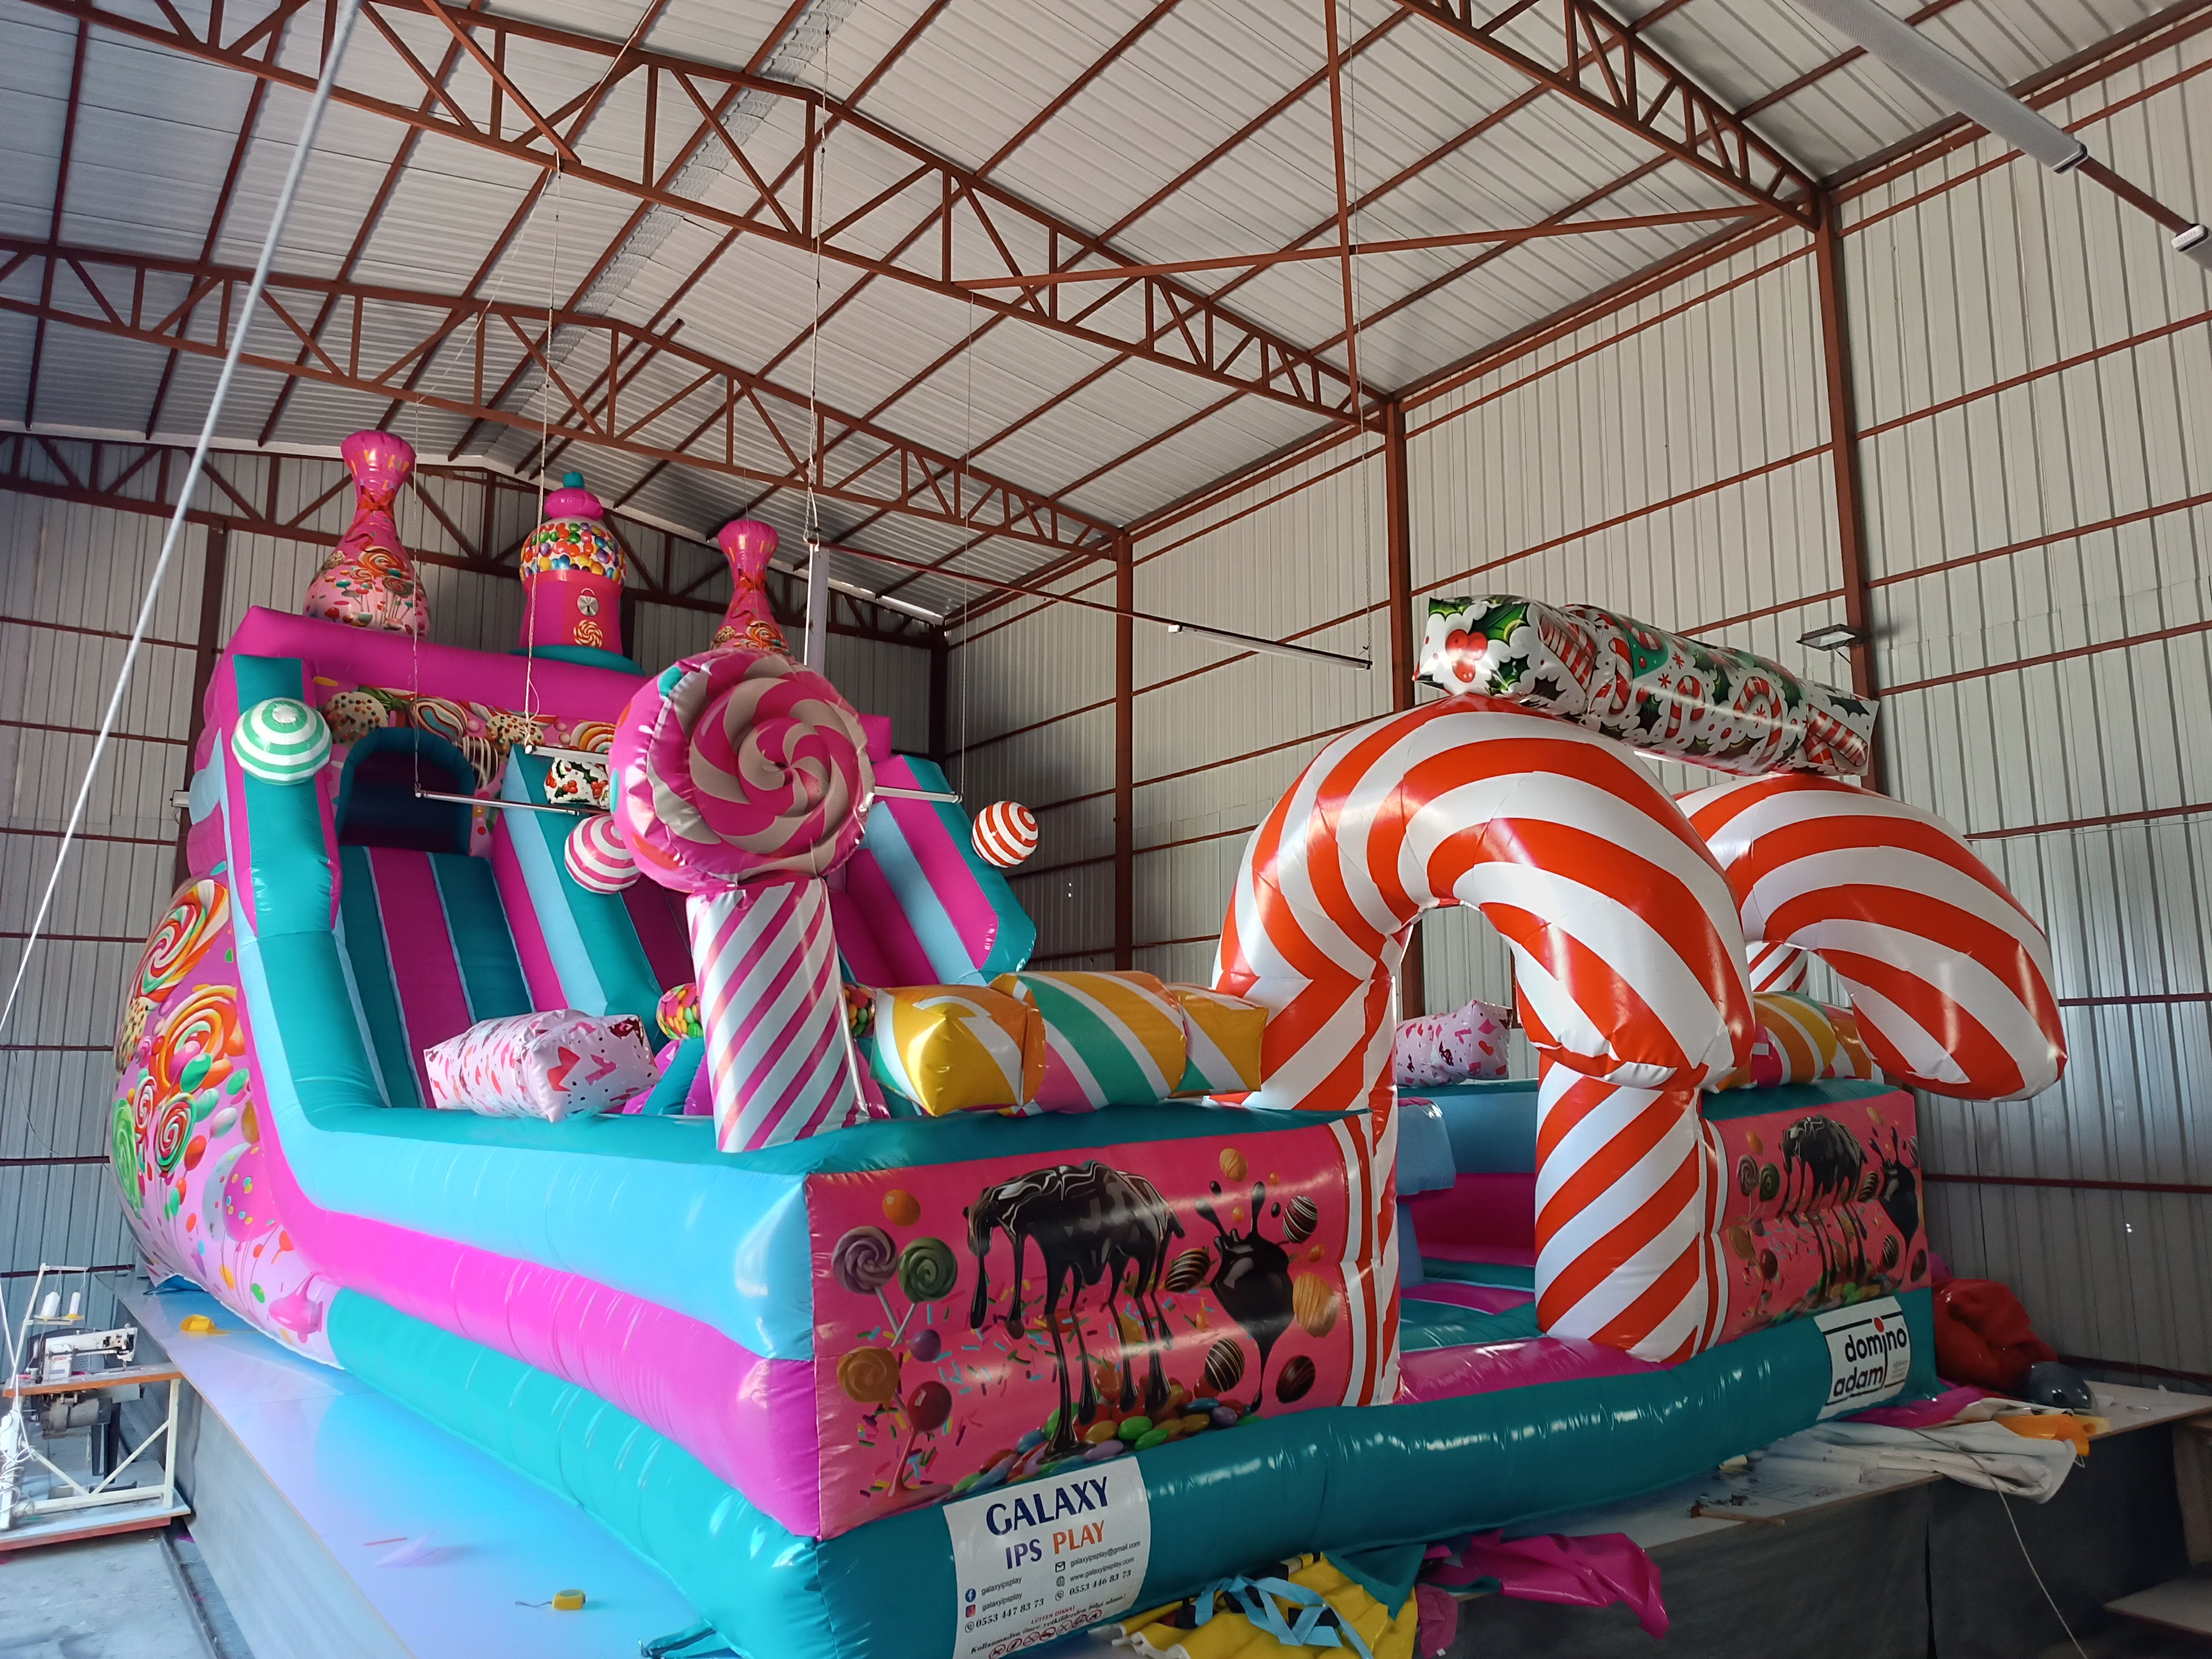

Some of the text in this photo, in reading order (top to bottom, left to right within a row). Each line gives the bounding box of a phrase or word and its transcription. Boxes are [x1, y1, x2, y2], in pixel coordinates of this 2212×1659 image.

[1844, 1317, 1907, 1362] domino
[1833, 1366, 1884, 1397] adam
[986, 1476, 1109, 1536] GALAXY
[1005, 1520, 1105, 1570] IPS PLAY
[1070, 1540, 1141, 1568] galaxyipsplay@gmail.com
[1069, 1557, 1135, 1582] www.galaxyipsplay.com
[1069, 1582, 1090, 1596] 0553
[1109, 1573, 1119, 1583] 83
[1122, 1569, 1131, 1579] 73
[981, 1577, 1022, 1596] galaxyipsplay
[976, 1613, 998, 1627] 0553
[1020, 1603, 1031, 1612] 83
[1034, 1598, 1044, 1608] 73
[982, 1592, 1023, 1612] galaxyipsplay
